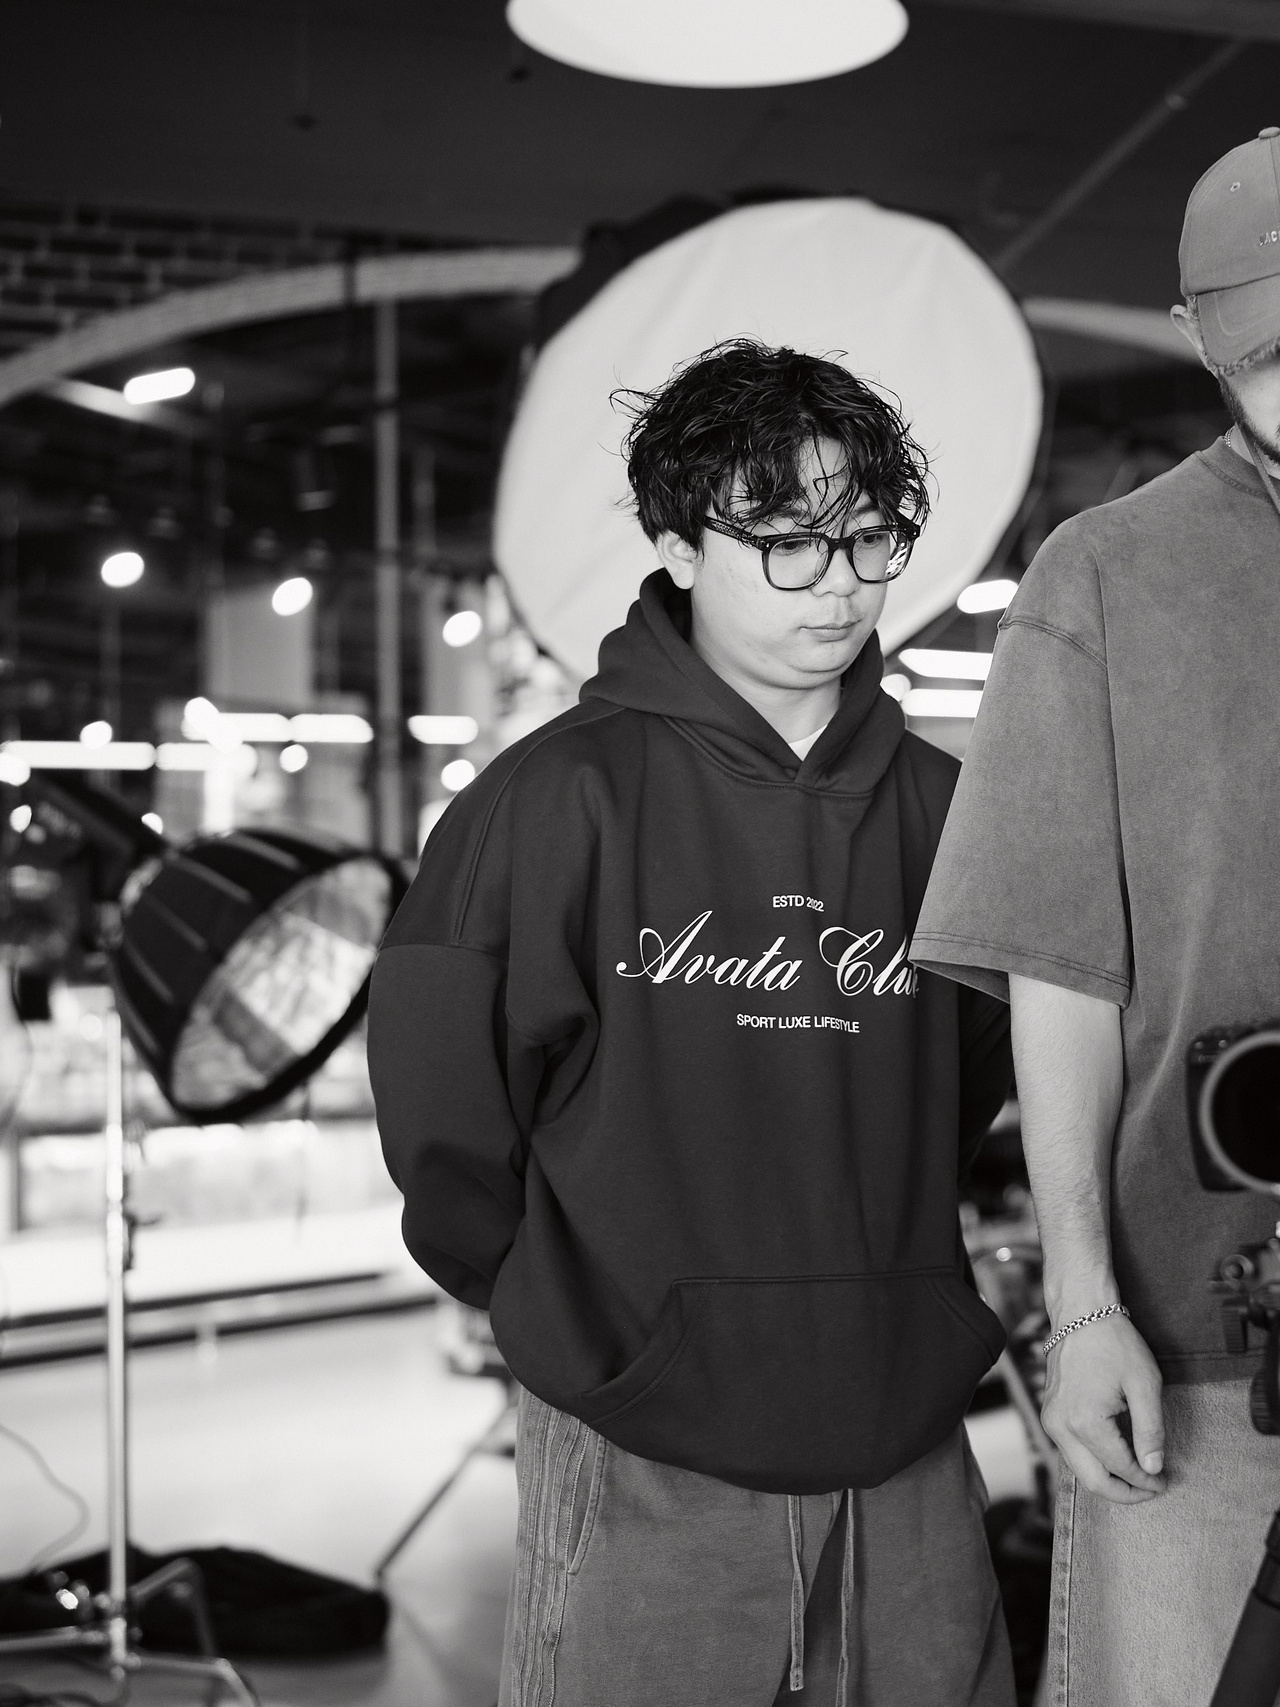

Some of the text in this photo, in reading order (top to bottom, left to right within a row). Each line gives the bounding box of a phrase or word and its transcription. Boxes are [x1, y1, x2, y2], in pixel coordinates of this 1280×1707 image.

[772, 895, 805, 908] ESTD
[616, 910, 803, 991] Avata
[736, 1013, 860, 1034] SPORT LUXE LIFESTYLE
